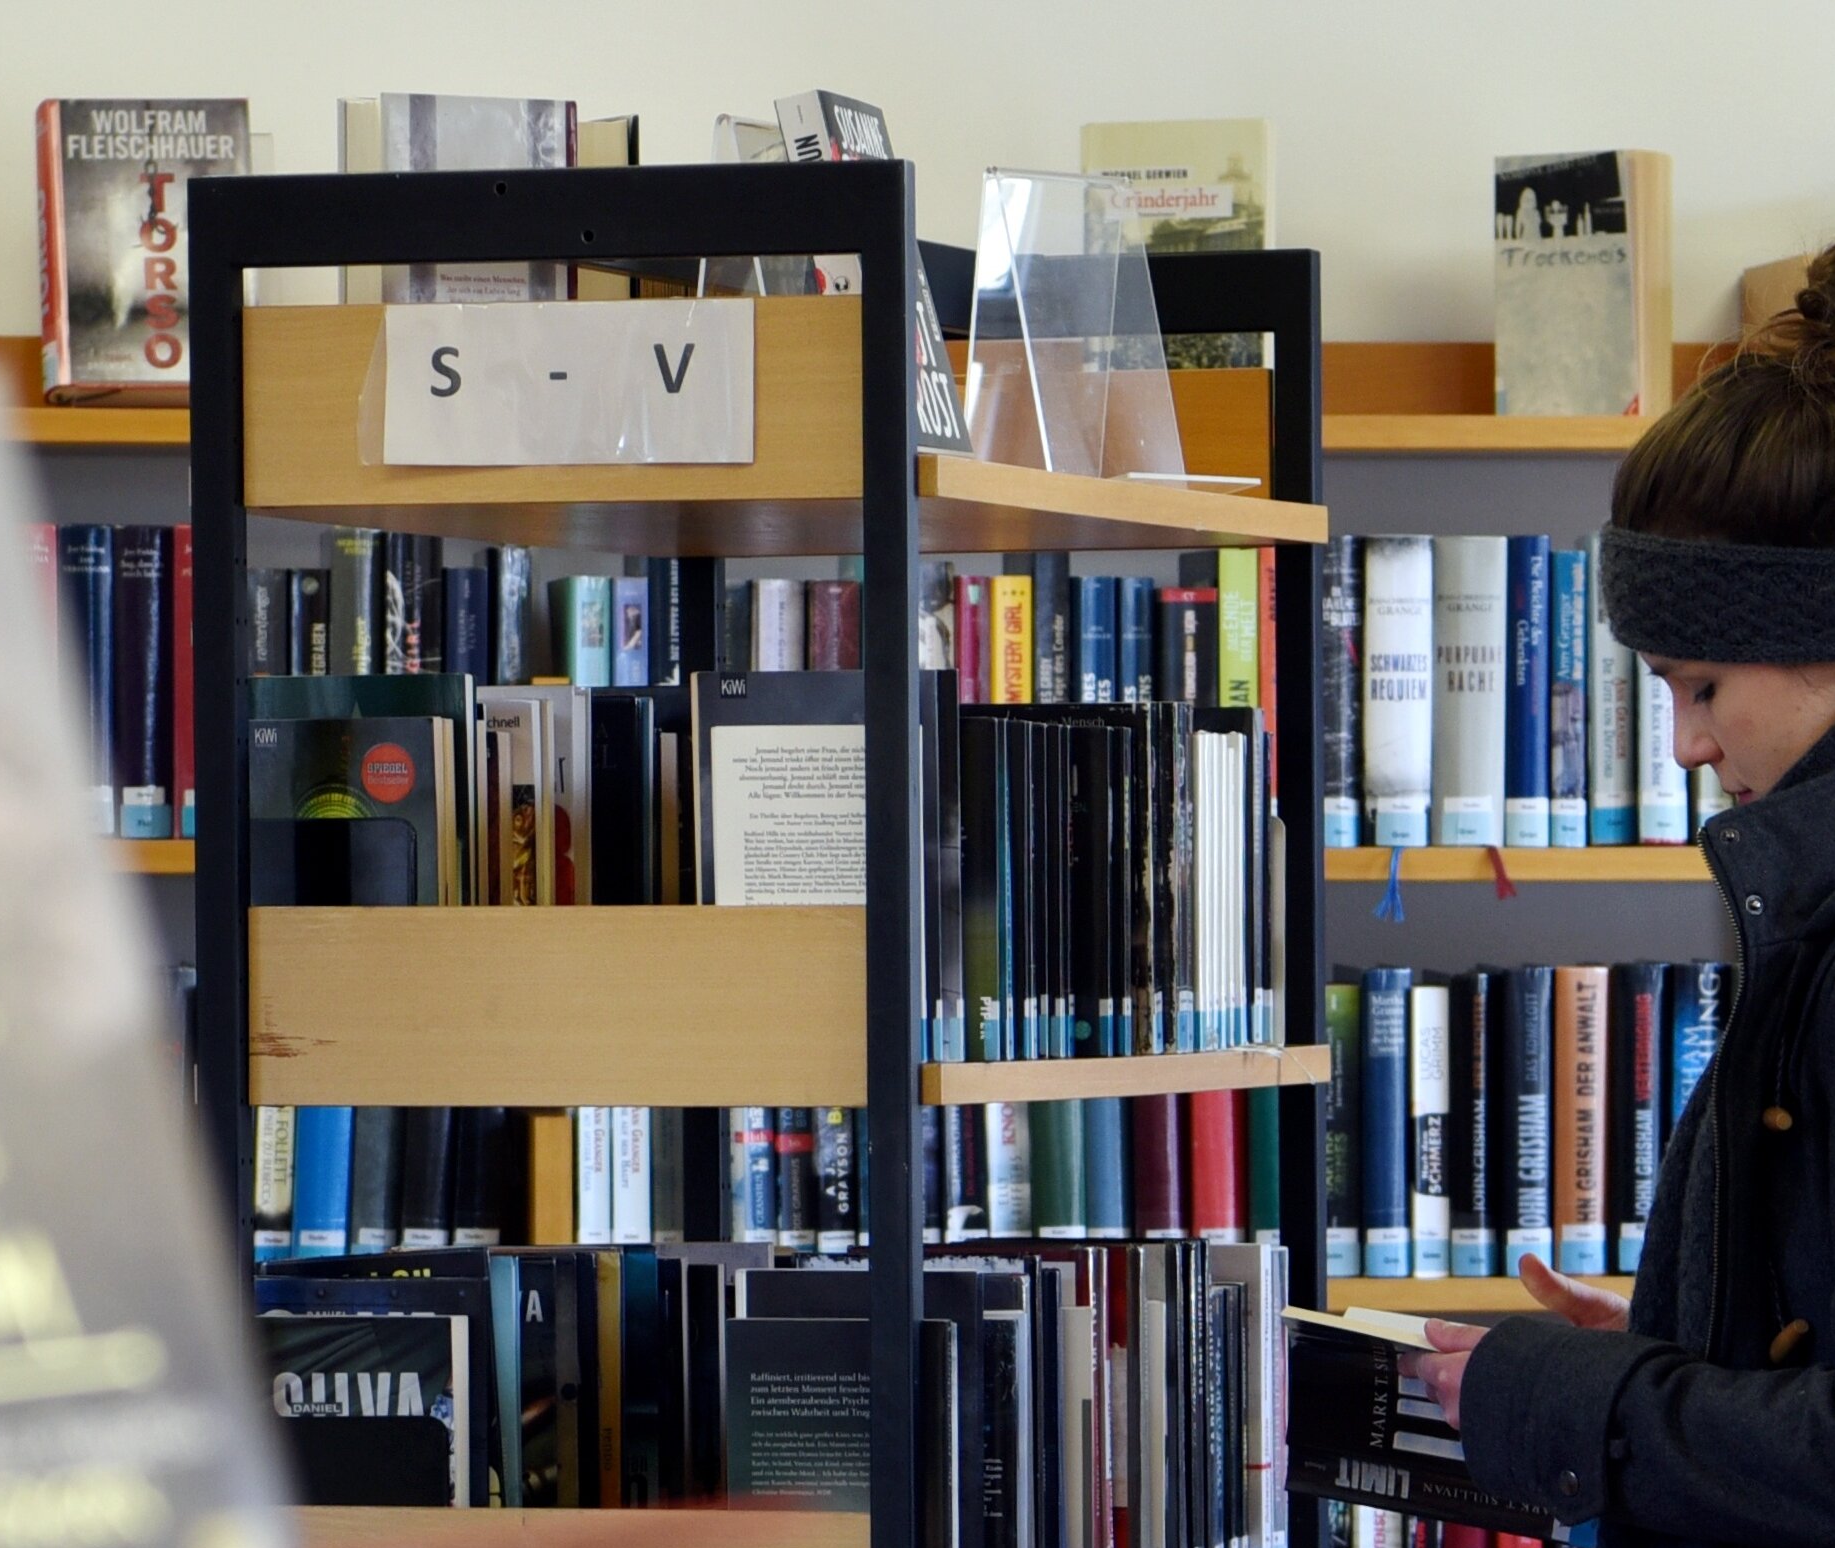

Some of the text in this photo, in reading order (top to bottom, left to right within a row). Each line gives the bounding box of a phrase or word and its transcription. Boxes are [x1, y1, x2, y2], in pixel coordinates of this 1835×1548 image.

[92, 109, 207, 134] WOLFRAM
[833, 104, 888, 158] SUSANNE
[67, 135, 235, 160] FLEISCHHAUER
[139, 172, 184, 369] TORSO
[430, 346, 462, 397] S
[654, 342, 696, 394] V
[1004, 603, 1023, 704] MYSTERY GIRL
[1370, 653, 1428, 672] SCHWARZES
[720, 679, 747, 697] KiWi
[1370, 679, 1427, 702] REQUIEM
[1447, 669, 1494, 692] RACHE
[253, 727, 278, 745] KiWi
[366, 762, 408, 775] SPIEGEL
[1577, 980, 1598, 1055] ANWALT
[1525, 1058, 1537, 1082] DAS
[1577, 1061, 1596, 1097] DER
[274, 1119, 289, 1185] FOLLETT
[1428, 1115, 1442, 1194] SCHMERZ
[1473, 1099, 1485, 1169] GRISHAM
[1518, 1093, 1546, 1181] GRISHAM
[1577, 1108, 1596, 1191] GRISHAM
[1635, 1109, 1653, 1176] GRISHAM
[836, 1132, 849, 1214] GRAYSON
[1473, 1173, 1485, 1211] JOHN
[293, 1403, 342, 1414] DANIEL
[1368, 1391, 1389, 1449] MARK
[1334, 1457, 1411, 1499] LIMIT
[1423, 1481, 1500, 1506] SULLIVAN
